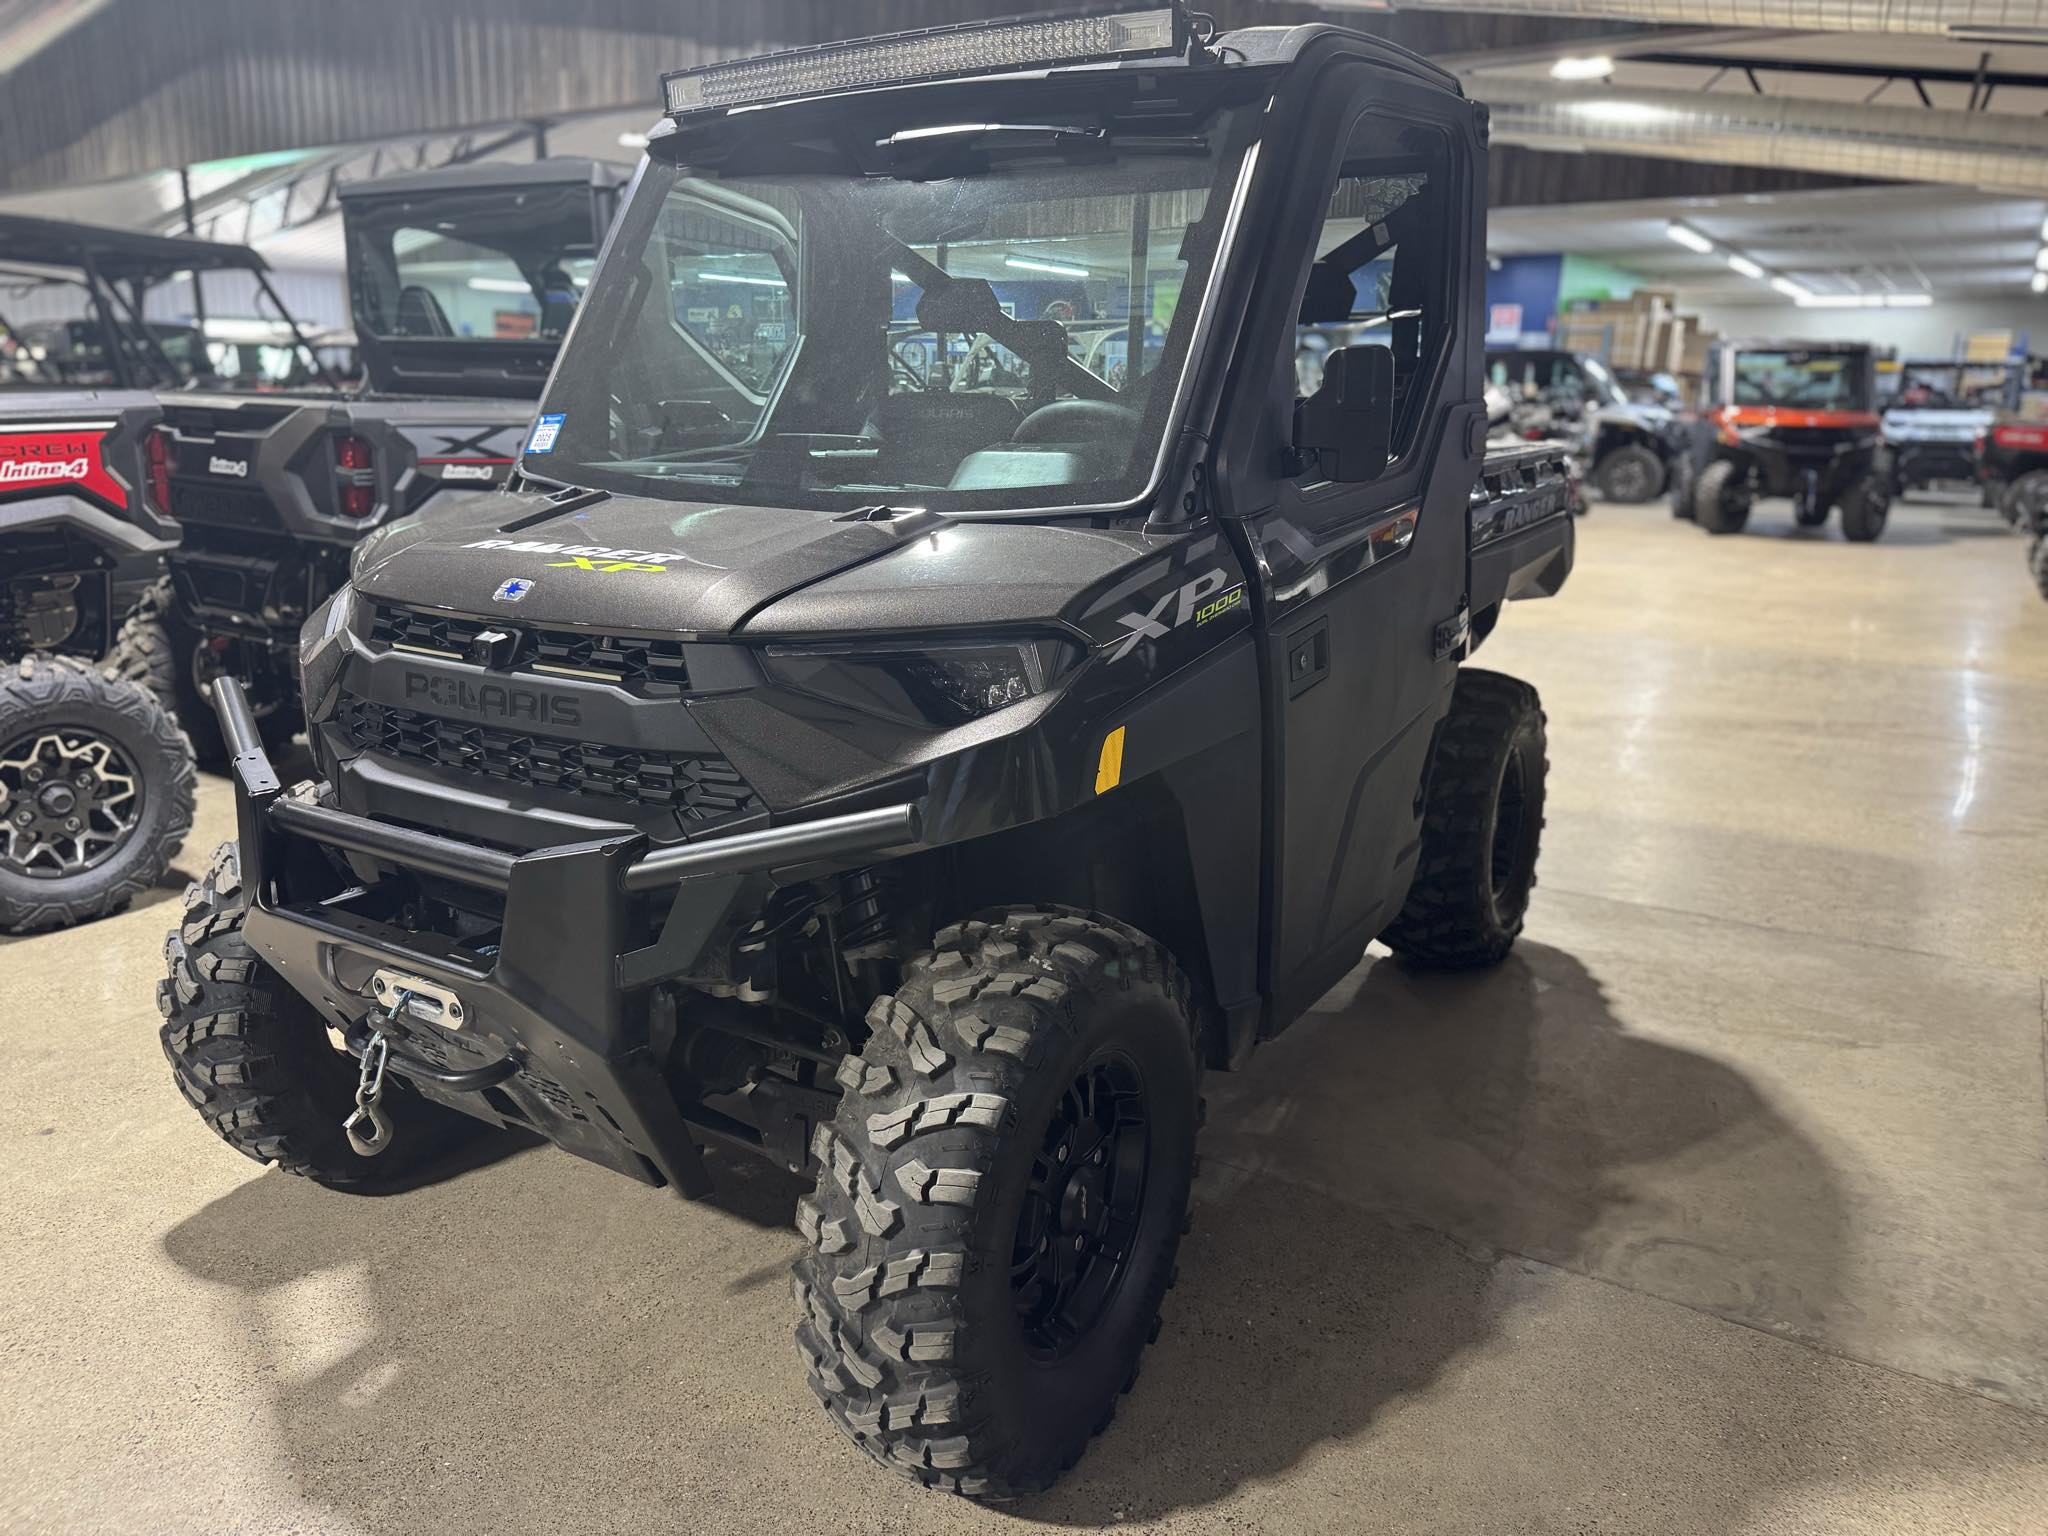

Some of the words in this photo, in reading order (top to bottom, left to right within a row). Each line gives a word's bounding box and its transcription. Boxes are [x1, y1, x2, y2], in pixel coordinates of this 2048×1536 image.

[1503, 494, 1556, 532] RANGER
[459, 540, 686, 564] RANGER
[544, 556, 667, 573] XP
[1106, 567, 1228, 665] XP
[1196, 588, 1242, 622] 1000
[405, 671, 583, 727] POLARIS
